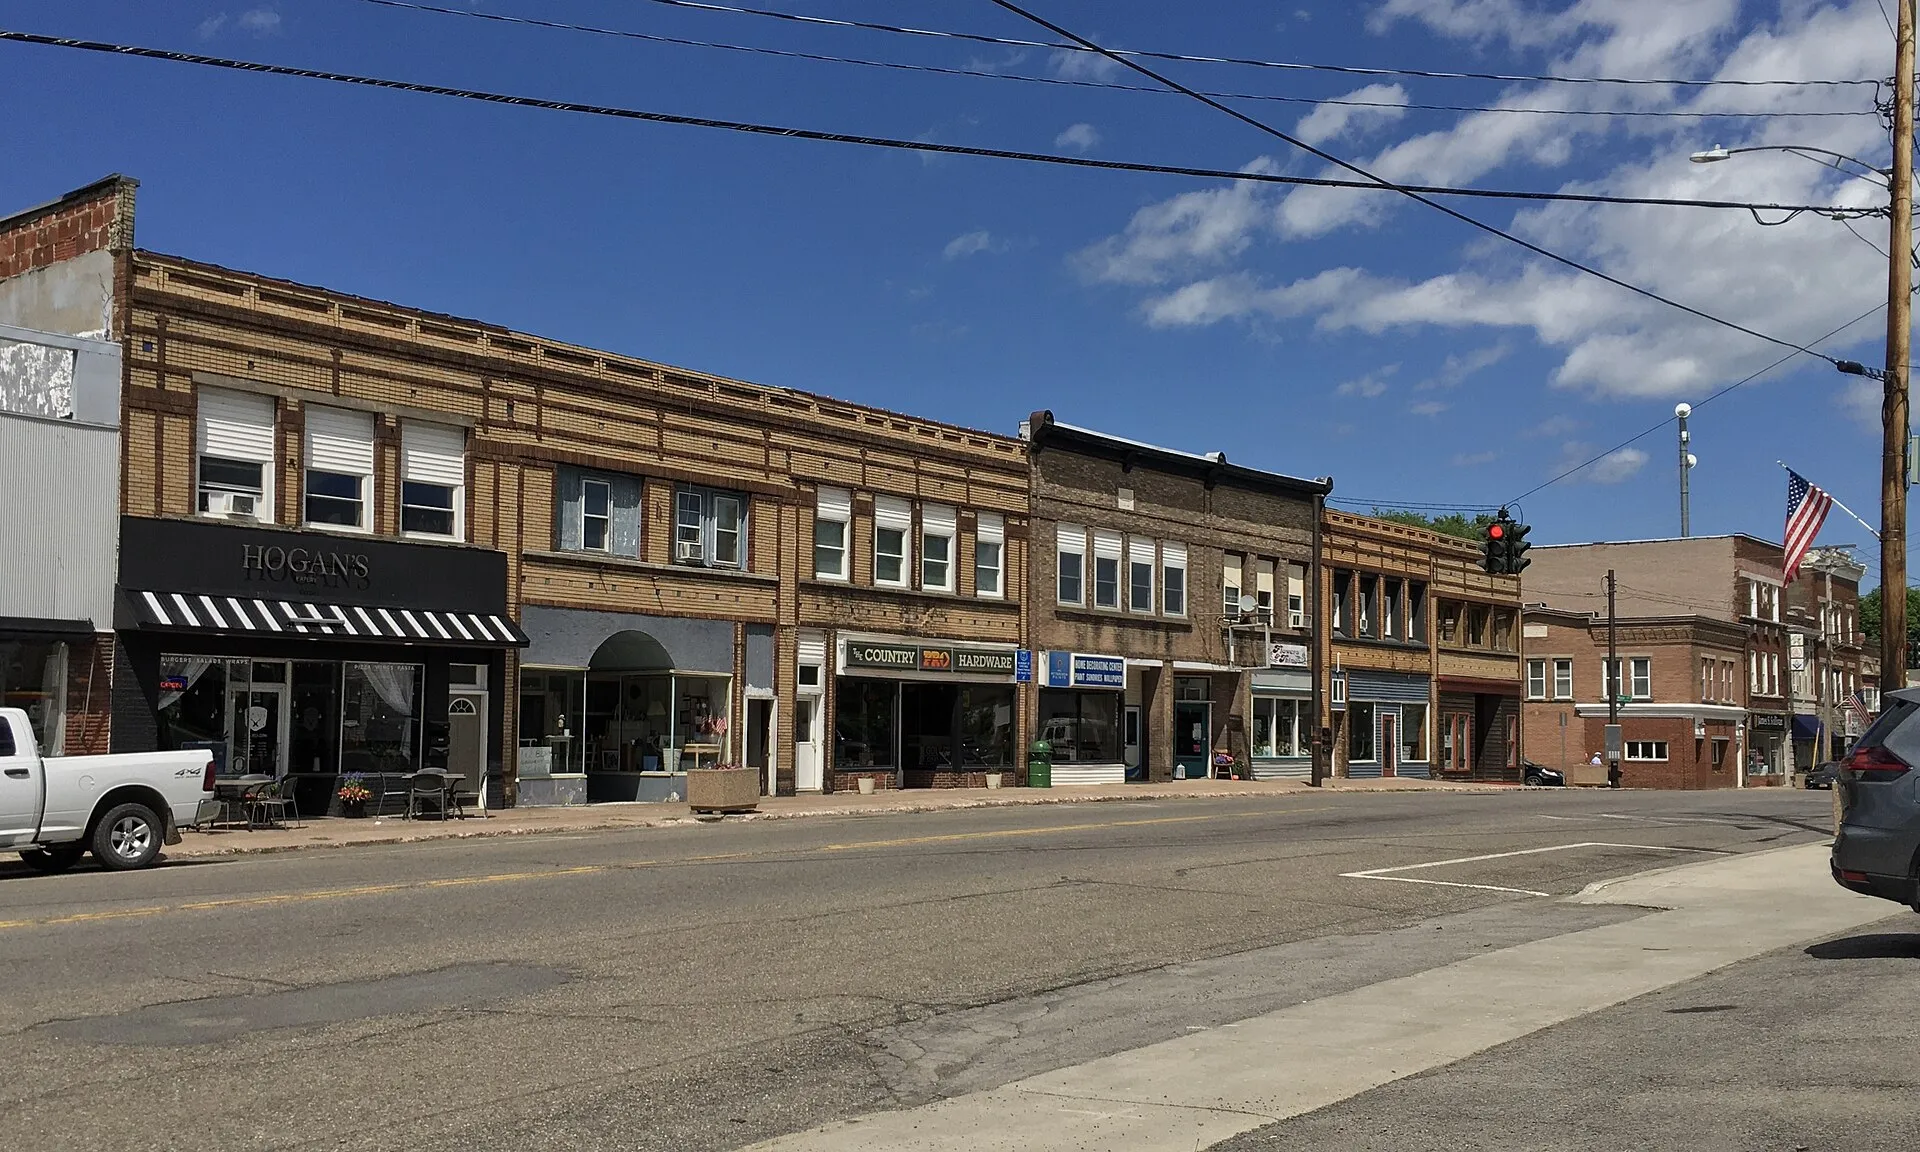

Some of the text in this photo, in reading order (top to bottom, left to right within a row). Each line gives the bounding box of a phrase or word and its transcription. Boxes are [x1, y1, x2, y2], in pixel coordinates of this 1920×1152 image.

[242, 544, 369, 578] HOGAN'S
[864, 649, 916, 664] COUNTRY
[958, 655, 1012, 669] HARDWARE
[1075, 659, 1122, 671] HOME DECORATING CENTER
[1075, 672, 1085, 681] PAINT
